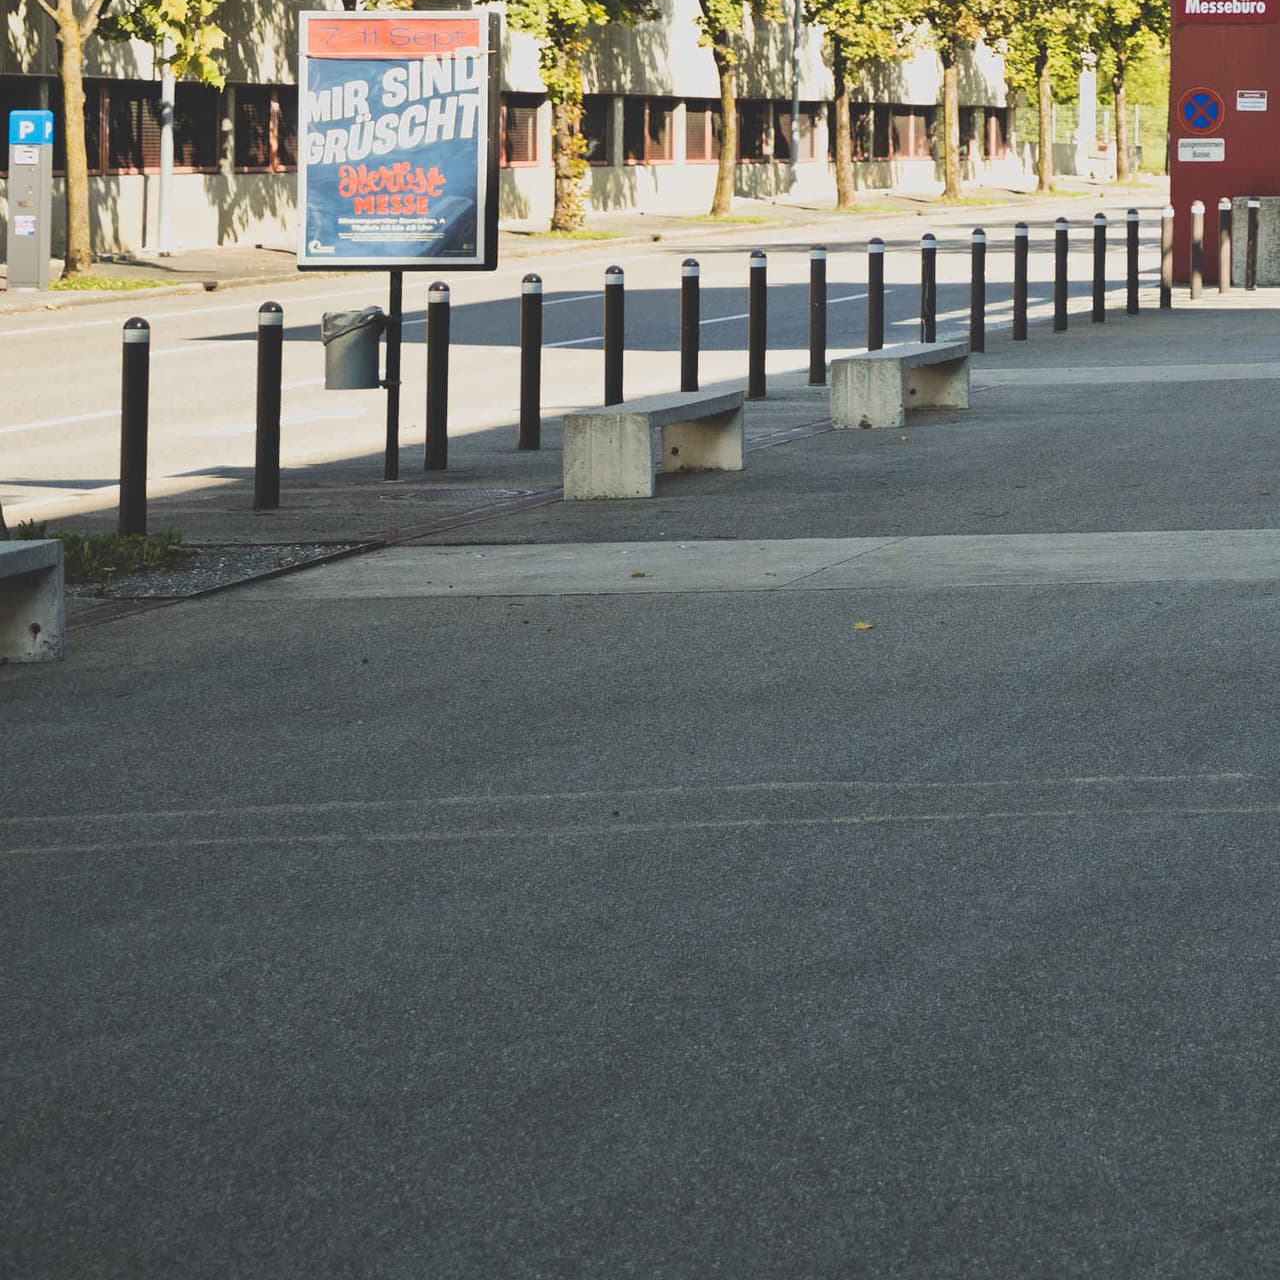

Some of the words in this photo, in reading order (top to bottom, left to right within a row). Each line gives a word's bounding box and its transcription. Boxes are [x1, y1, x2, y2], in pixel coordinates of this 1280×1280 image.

[389, 26, 468, 52] Sept
[306, 79, 371, 123] MIR
[382, 46, 479, 108] SIND
[19, 120, 35, 139] P
[305, 93, 479, 165] GRÜSCHT
[338, 161, 447, 198] Herbst
[353, 194, 430, 216] MESSE
